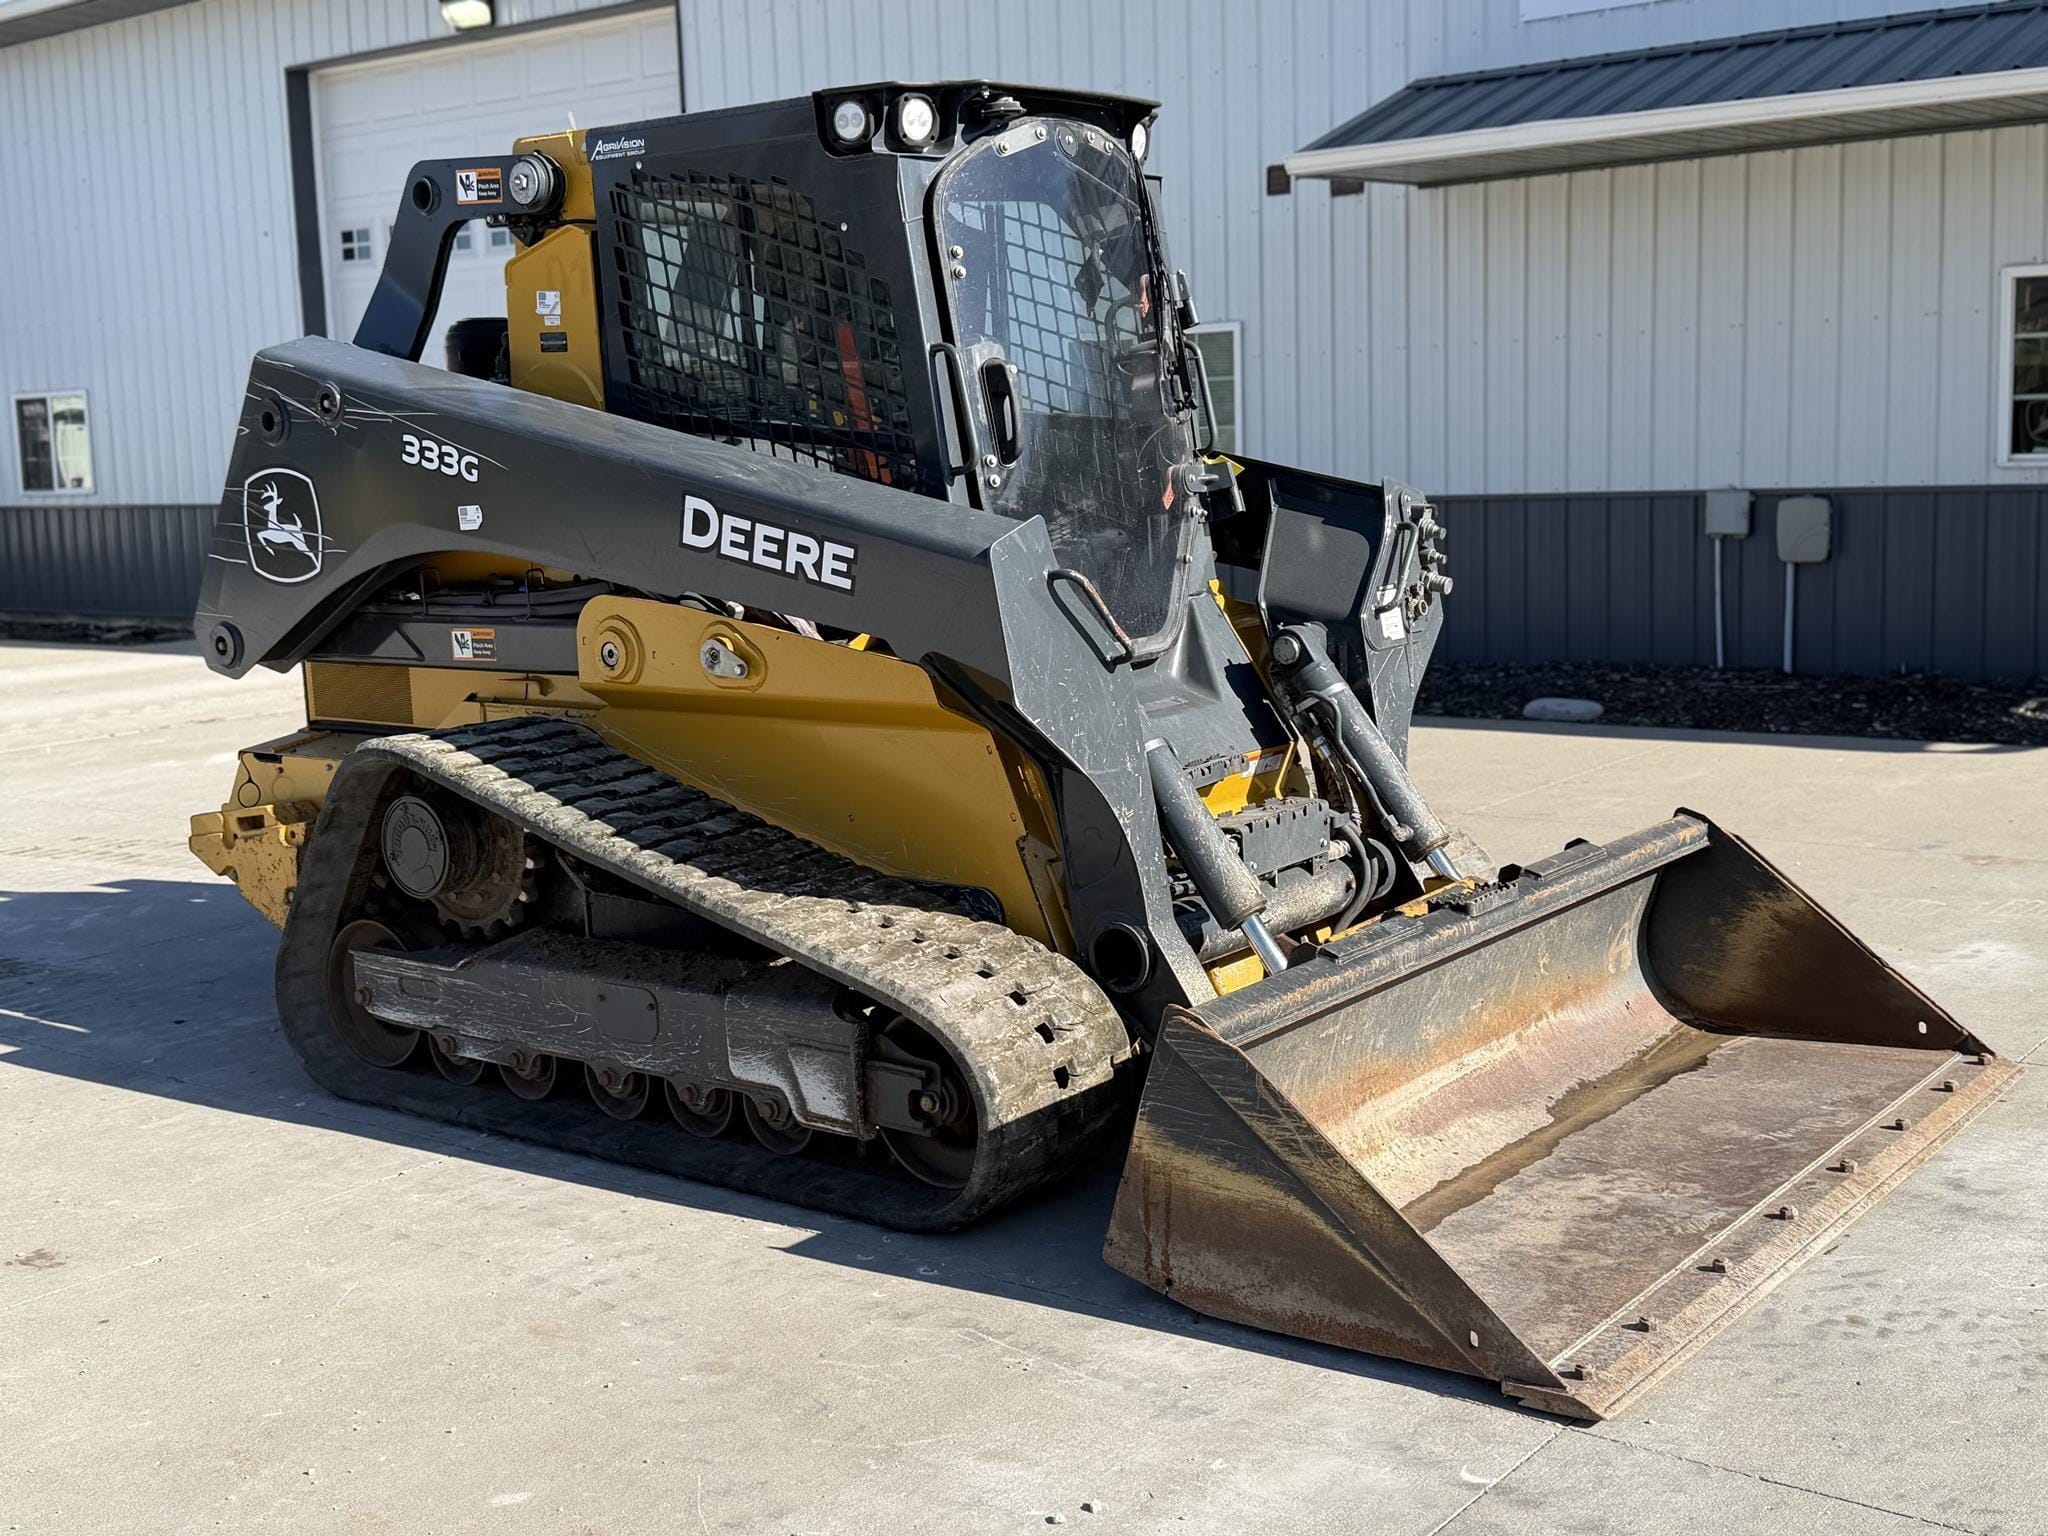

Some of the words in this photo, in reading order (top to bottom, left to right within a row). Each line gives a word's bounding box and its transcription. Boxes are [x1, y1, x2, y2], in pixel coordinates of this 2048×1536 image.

[595, 152, 625, 160] EQUIPMENT
[402, 434, 479, 482] 333G
[682, 494, 855, 590] DEERE
